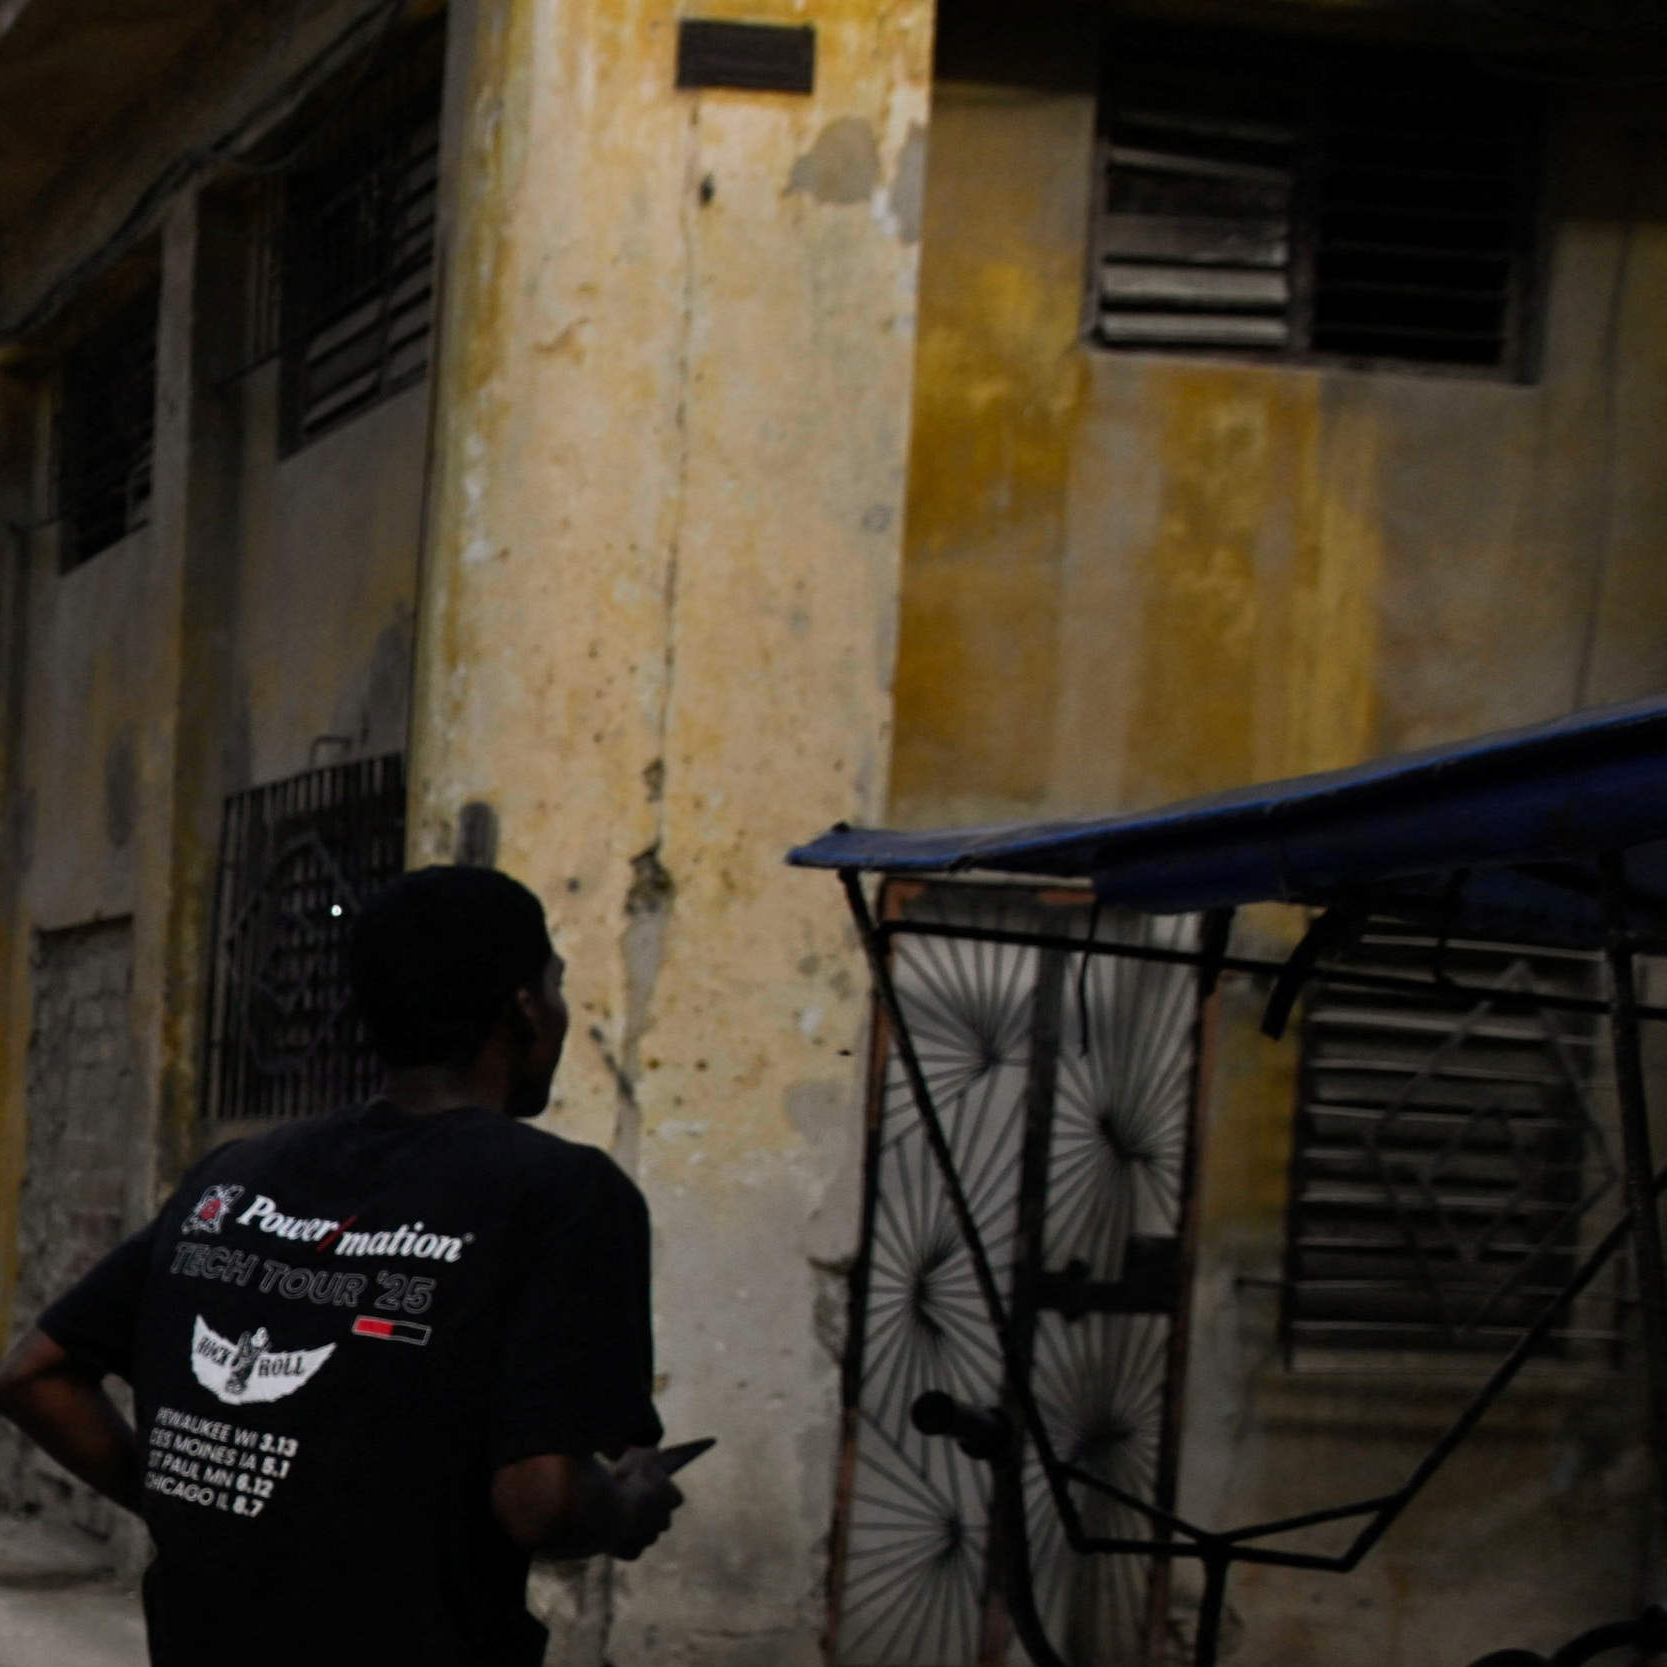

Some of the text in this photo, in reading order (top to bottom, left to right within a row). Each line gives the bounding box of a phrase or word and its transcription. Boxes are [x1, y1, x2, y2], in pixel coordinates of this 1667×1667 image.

[170, 1241, 260, 1288] TECH
[259, 1258, 368, 1308] TOUR
[257, 1355, 306, 1377] ROLL
[172, 1433, 239, 1467] MOINES
[238, 1451, 258, 1472] IA
[233, 1427, 259, 1449] WI
[160, 1452, 202, 1481] PAUL
[202, 1465, 236, 1489] MN
[144, 1471, 216, 1507] CHICAGO
[215, 1491, 230, 1511] IL
